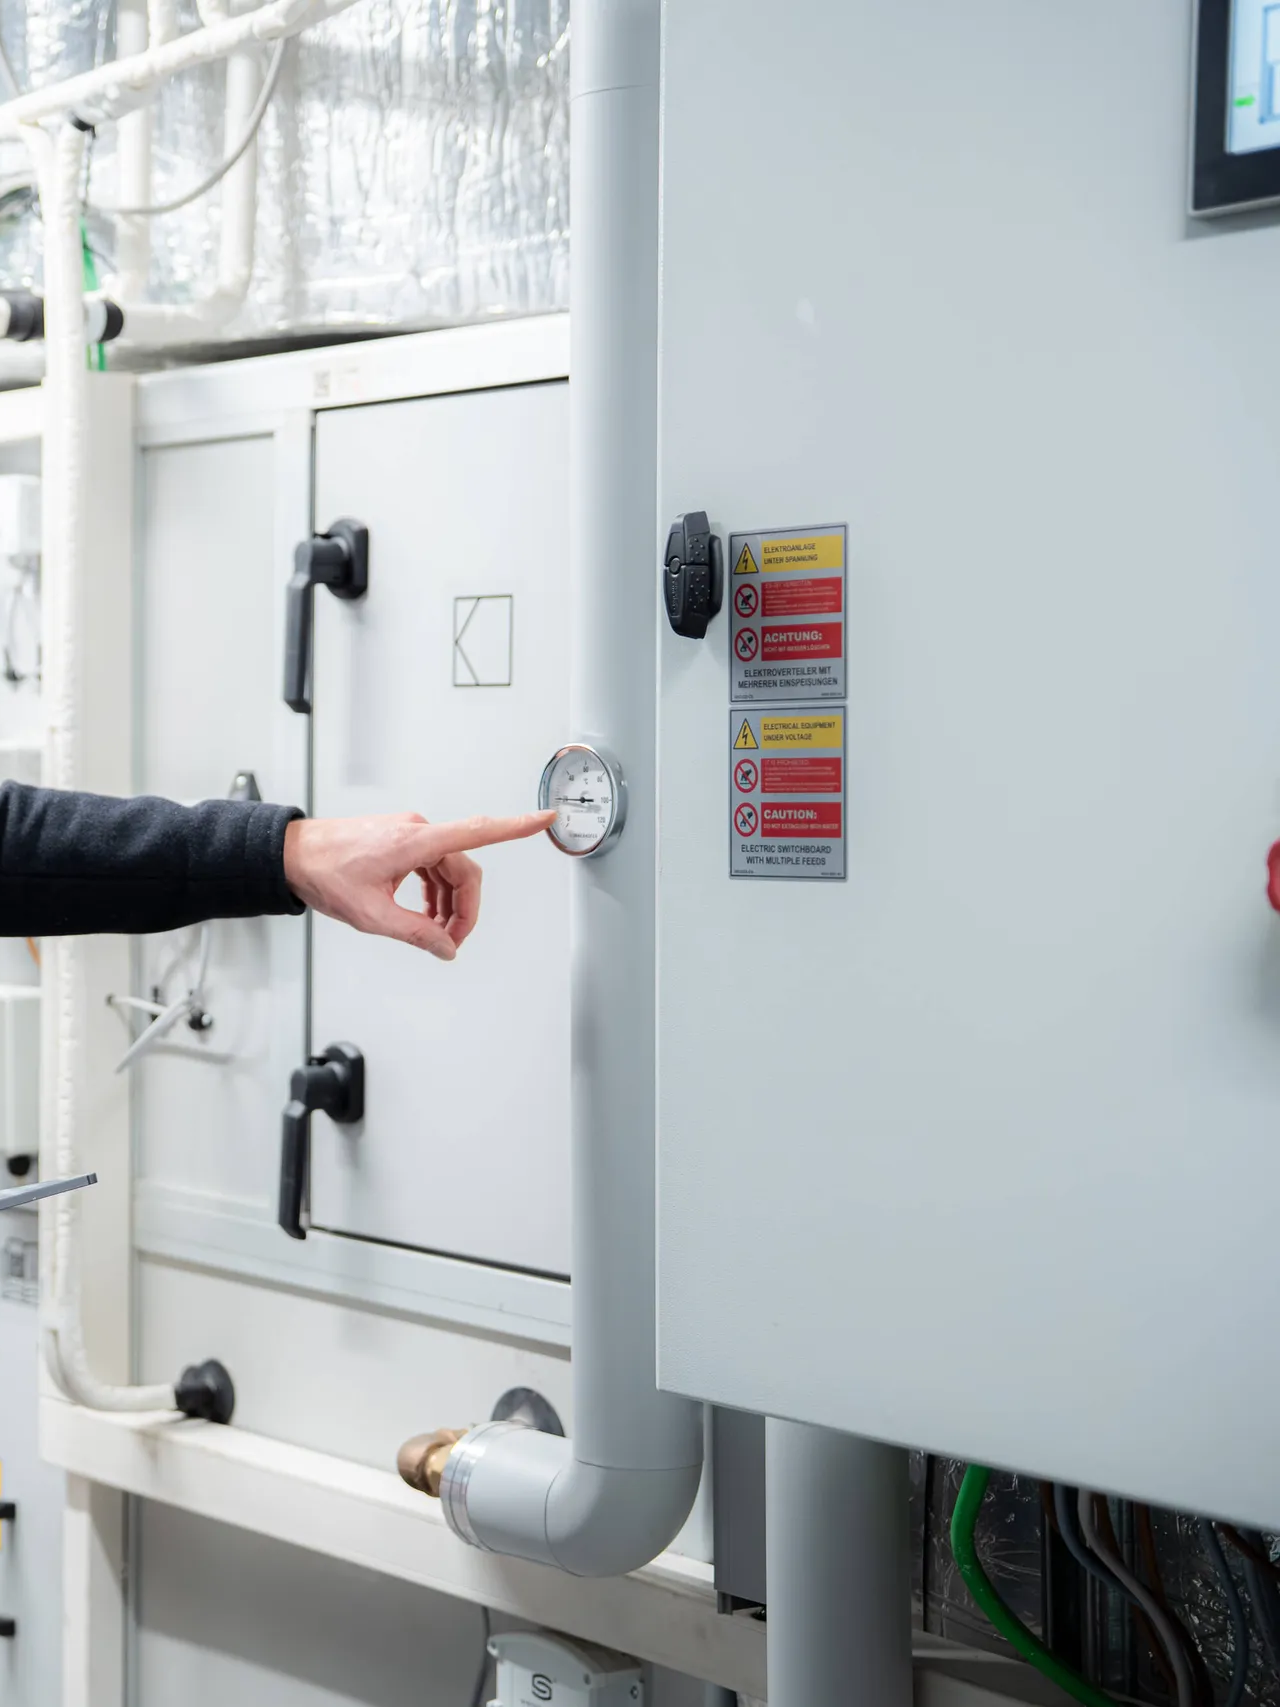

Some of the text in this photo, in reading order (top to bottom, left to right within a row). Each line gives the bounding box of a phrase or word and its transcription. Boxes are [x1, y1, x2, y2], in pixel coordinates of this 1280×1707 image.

[763, 543, 816, 554] ELEKTROANLAGE
[763, 554, 818, 565] UNTER SPANNUNG
[764, 631, 823, 643] ACHTUNG:
[744, 666, 832, 678] ELEKTROVERTEILER MIT
[738, 677, 838, 688] MEHREREN EINSPEISUNGEN
[785, 733, 812, 741] VOLTAGE
[764, 809, 817, 819] CAUTION:
[741, 844, 832, 853] ELECTRIC SWITCHBOARD
[746, 856, 826, 865] WITH MULTIPLE FEEDS
